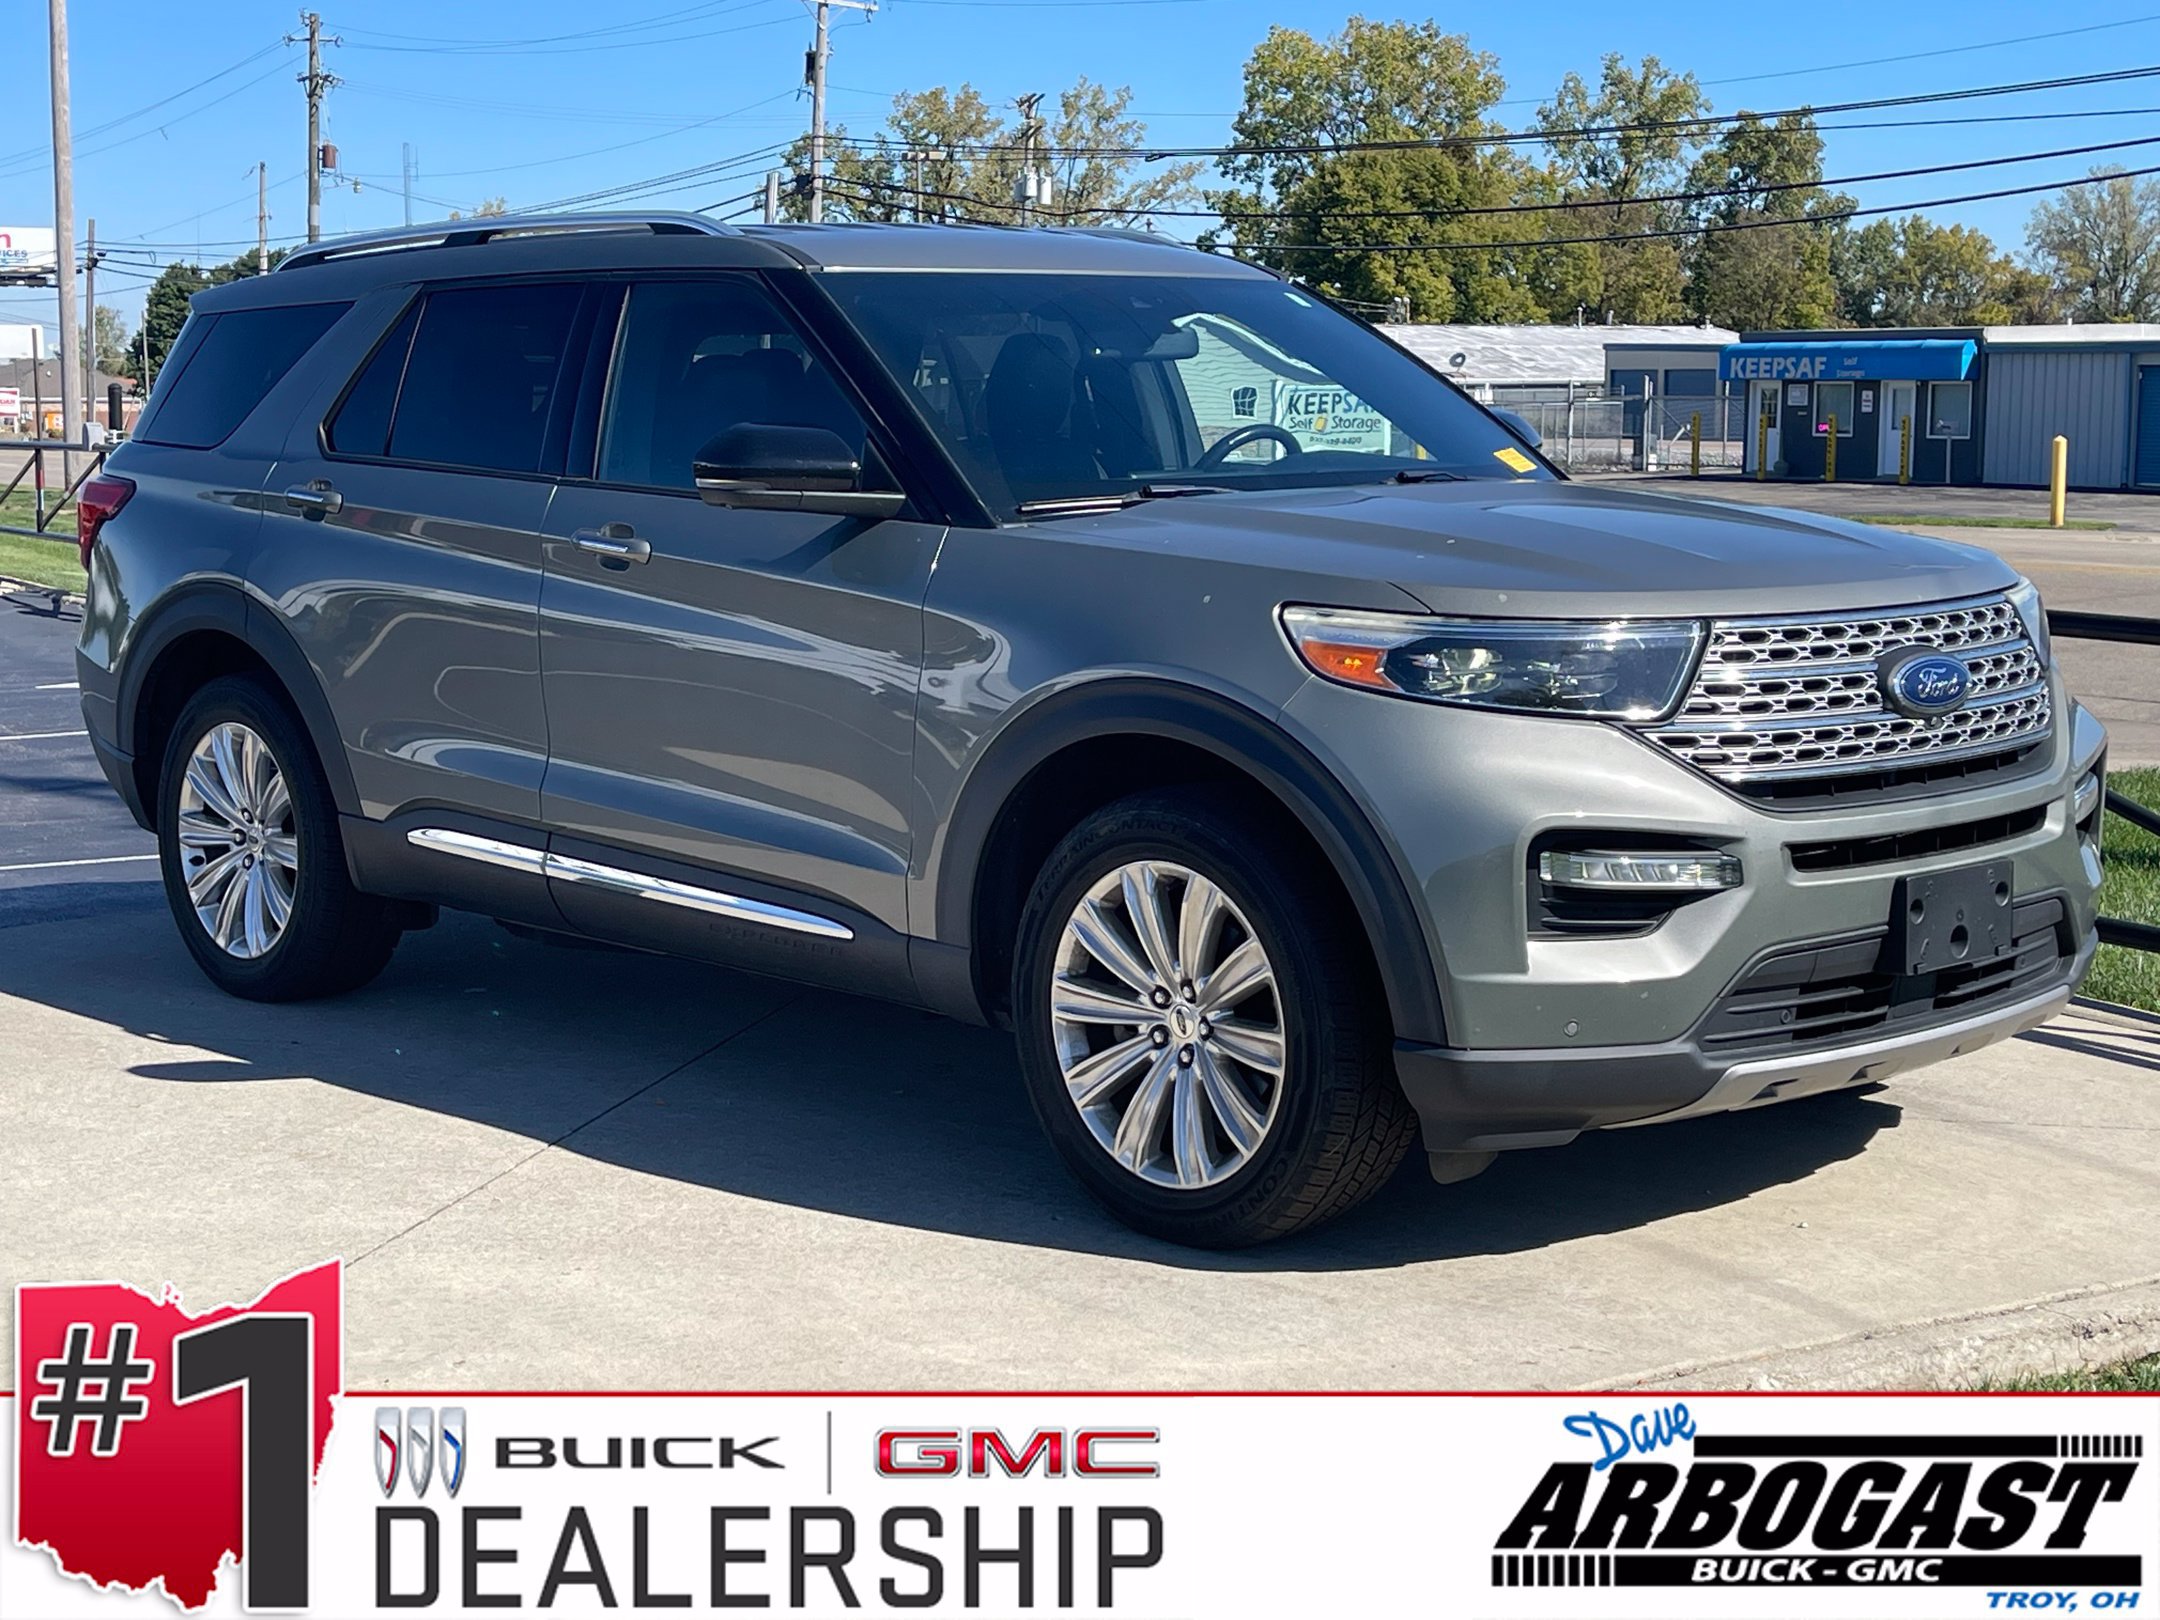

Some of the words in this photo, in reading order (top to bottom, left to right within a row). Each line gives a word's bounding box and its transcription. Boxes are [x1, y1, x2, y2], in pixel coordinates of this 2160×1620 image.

[1729, 356, 1827, 379] KEEPSAF
[1288, 392, 1375, 415] KEEPSA
[1288, 416, 1313, 429] Self
[1331, 415, 1381, 433] Storage
[1917, 666, 1960, 699] Ford
